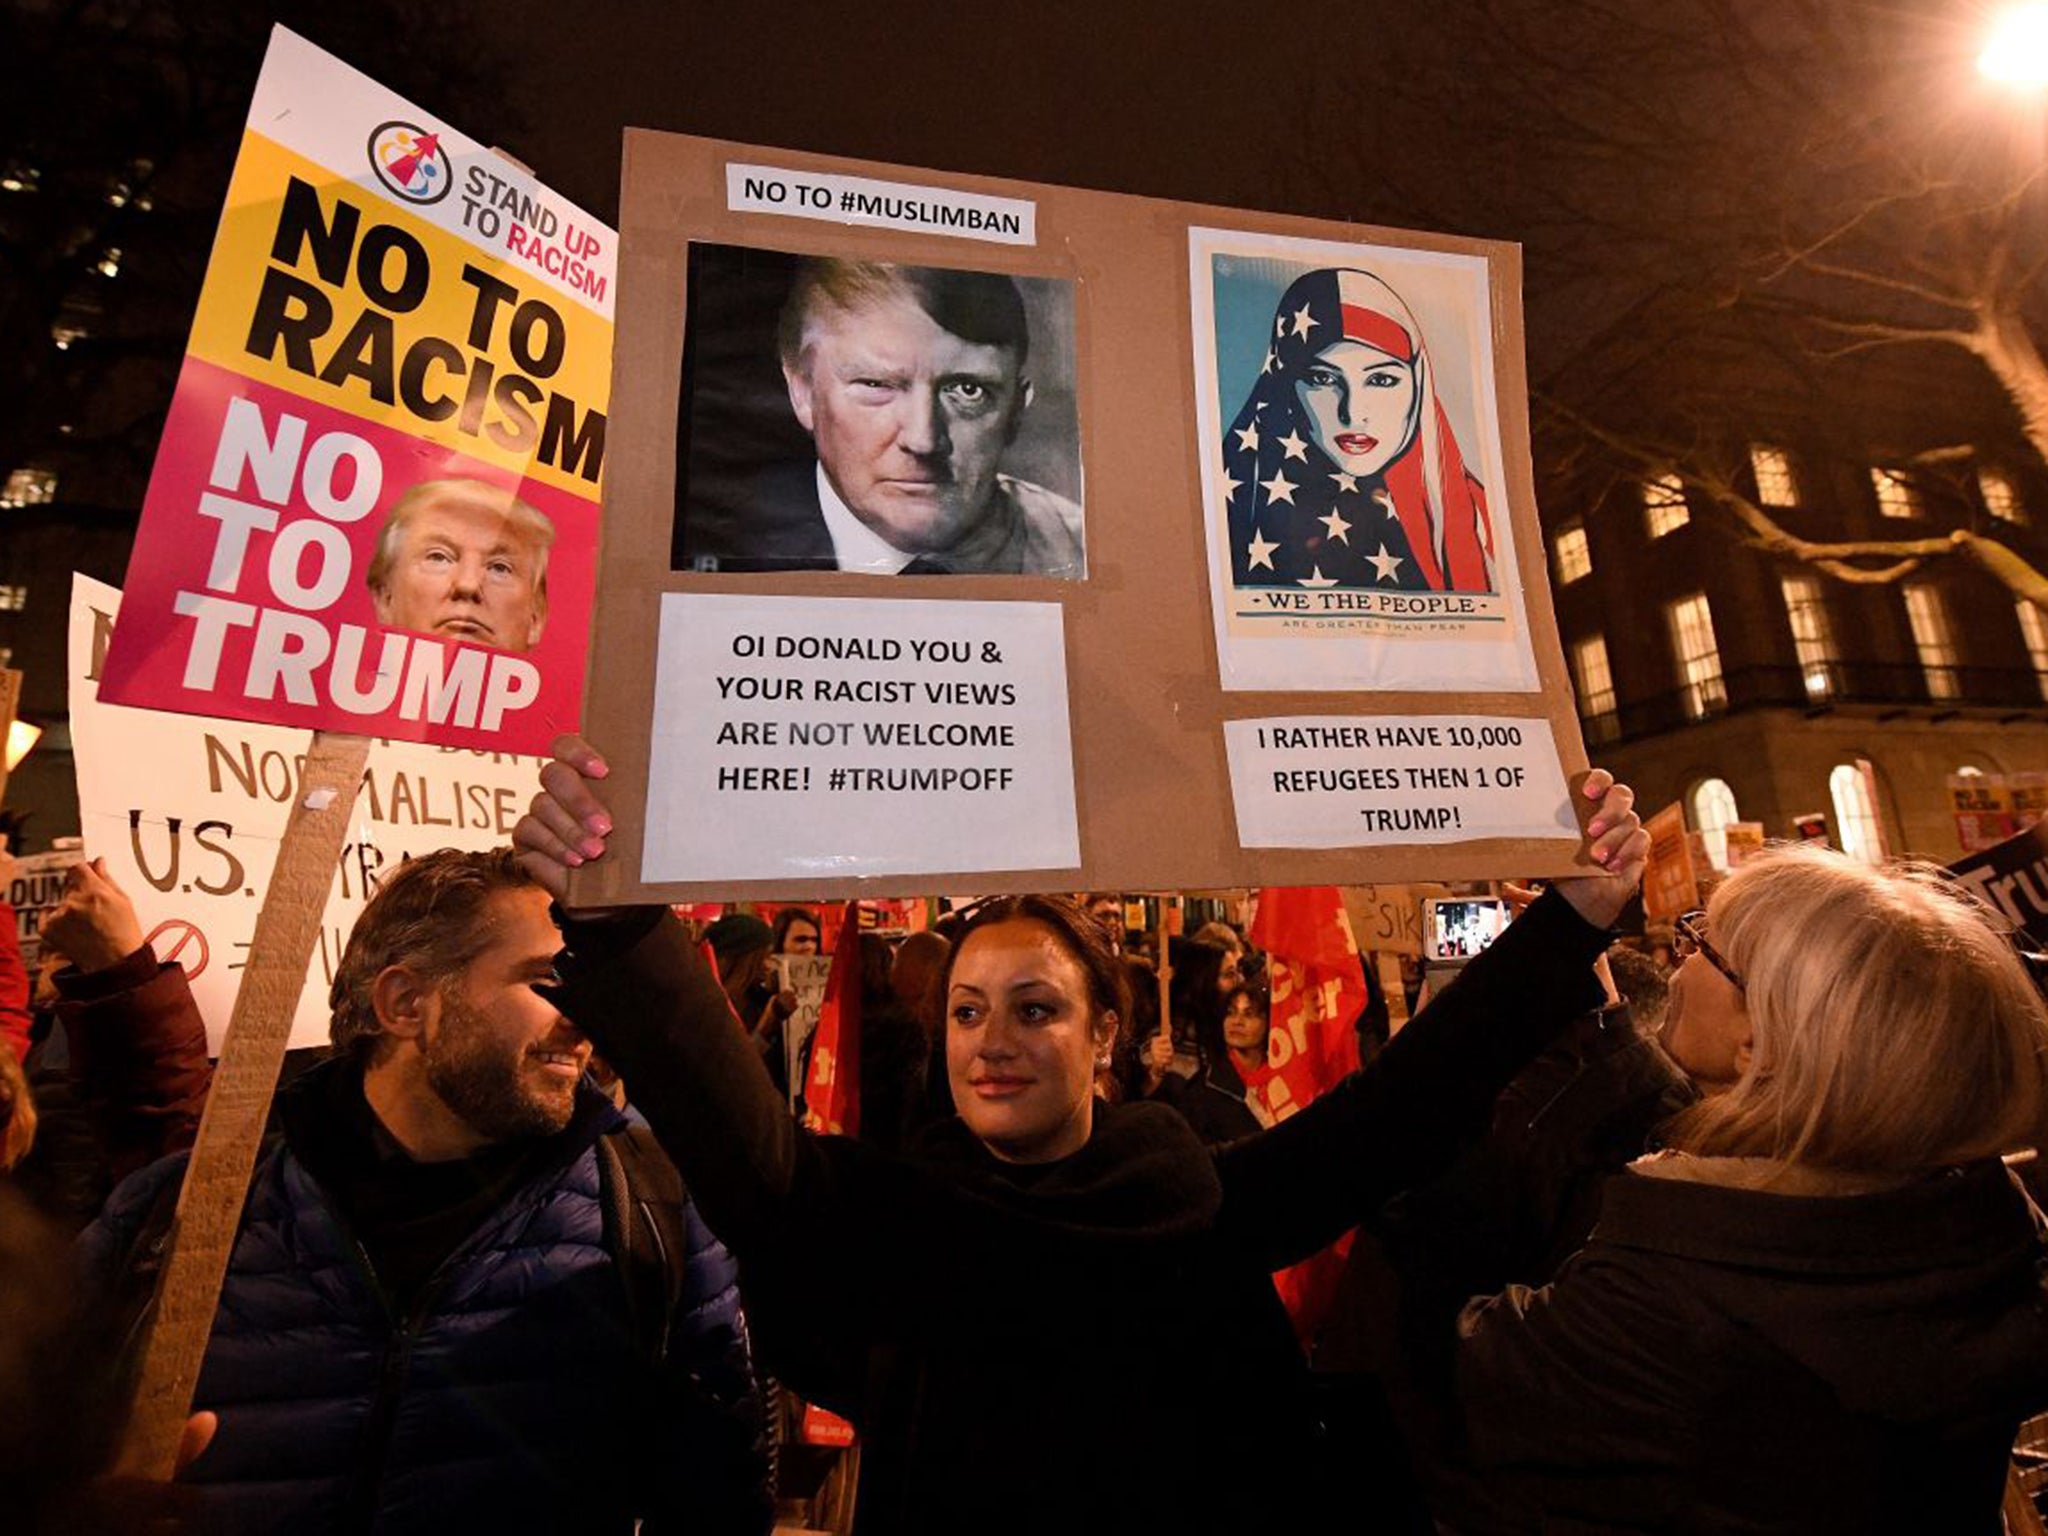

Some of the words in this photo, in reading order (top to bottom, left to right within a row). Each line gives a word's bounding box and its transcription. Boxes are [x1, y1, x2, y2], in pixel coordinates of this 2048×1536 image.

[465, 165, 558, 238] STAND
[565, 223, 601, 261] UP
[744, 178, 787, 203] NO
[795, 184, 832, 209] TO
[840, 190, 1020, 235] #MUSLIMBAN
[271, 174, 430, 314] NO
[461, 262, 566, 380] TO
[461, 194, 501, 239] TO
[506, 222, 607, 303] RACISM
[245, 266, 607, 484] RACISM
[208, 395, 384, 522] NO
[198, 491, 352, 611] TO
[1265, 592, 1311, 610] WE
[1317, 593, 1372, 611] THE
[1379, 595, 1476, 613] PEOPLE
[173, 590, 541, 733] TRUMP
[732, 634, 765, 659] OI
[775, 636, 901, 662] DONALD
[909, 639, 971, 663] YOU
[979, 641, 1003, 664] &
[716, 676, 804, 701] YOUR
[813, 680, 917, 704] RACIST
[924, 683, 1017, 706] VIEWS
[716, 722, 778, 746] ARE
[788, 722, 855, 747] NOT
[863, 722, 1015, 747] WELCOME
[1258, 728, 1266, 749] I
[1273, 728, 1370, 749] RATHER
[1376, 727, 1442, 748] HAVE
[1446, 726, 1522, 750] 10,000
[717, 766, 811, 791] HERE!
[828, 767, 1014, 792] #TRUMPOFF
[1273, 768, 1400, 793] REFUGEES
[1405, 767, 1470, 789] THEN
[1476, 767, 1489, 788] 1
[1495, 767, 1525, 788] OF
[1361, 806, 1462, 832] TRUMP!
[129, 809, 256, 897] U.S.
